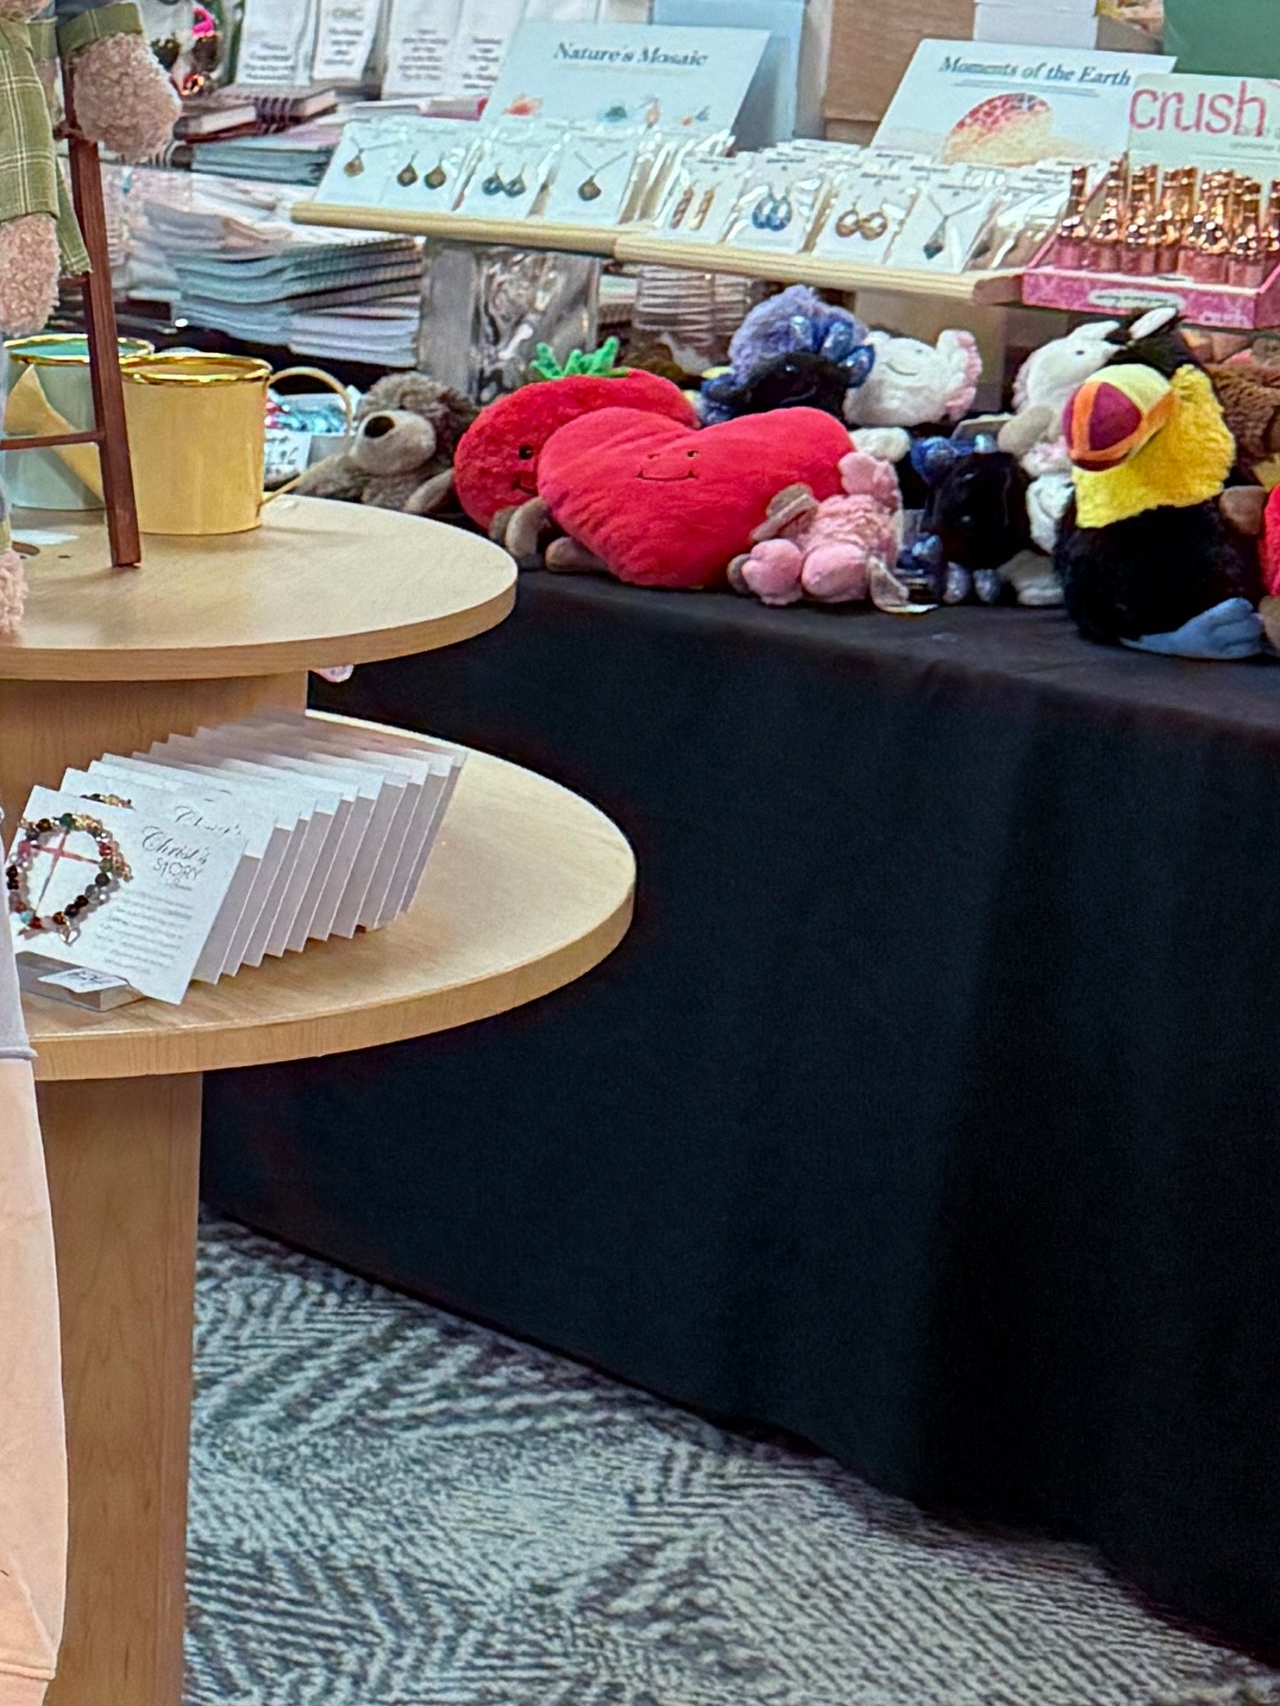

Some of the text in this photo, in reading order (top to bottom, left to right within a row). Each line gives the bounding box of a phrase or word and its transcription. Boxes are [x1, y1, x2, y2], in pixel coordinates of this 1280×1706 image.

[553, 42, 708, 66] Nature's Mosaic
[939, 56, 1132, 86] Moments of the Earth
[1129, 80, 1267, 138] crush
[142, 825, 210, 865] Christ's
[153, 857, 203, 881] STORY
